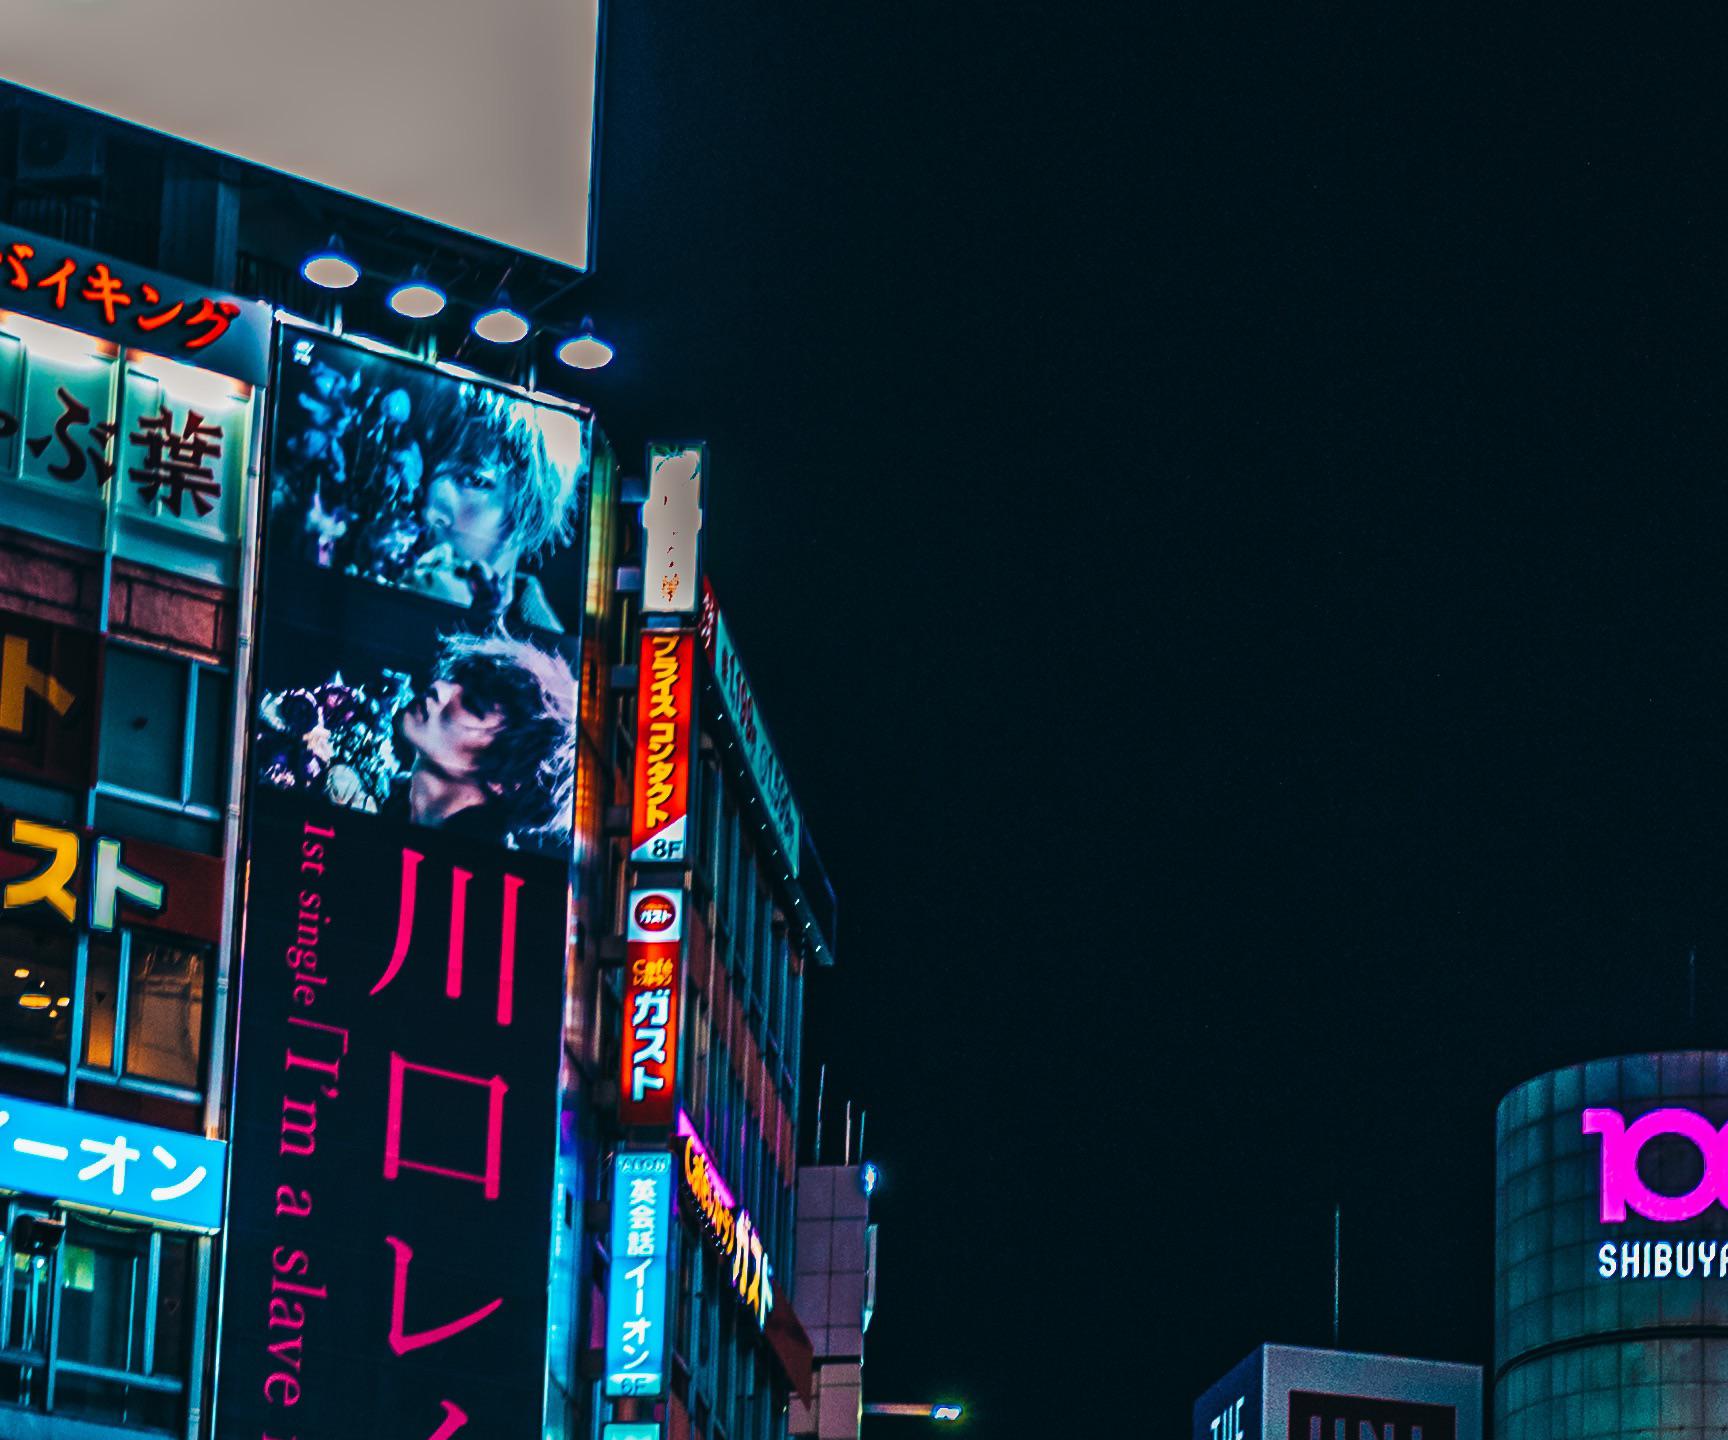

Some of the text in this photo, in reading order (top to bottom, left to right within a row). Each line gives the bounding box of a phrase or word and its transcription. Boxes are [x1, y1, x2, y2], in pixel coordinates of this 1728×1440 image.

[0, 243, 241, 348] バイキング
[301, 820, 336, 876] 1st
[652, 838, 682, 860] 8F
[286, 892, 335, 1007] single
[632, 988, 672, 1102] ガスト
[0, 1110, 207, 1201] ーオン
[274, 1185, 310, 1218] a
[263, 1246, 328, 1408] slave
[620, 1178, 658, 1372] 英会話 イーオン
